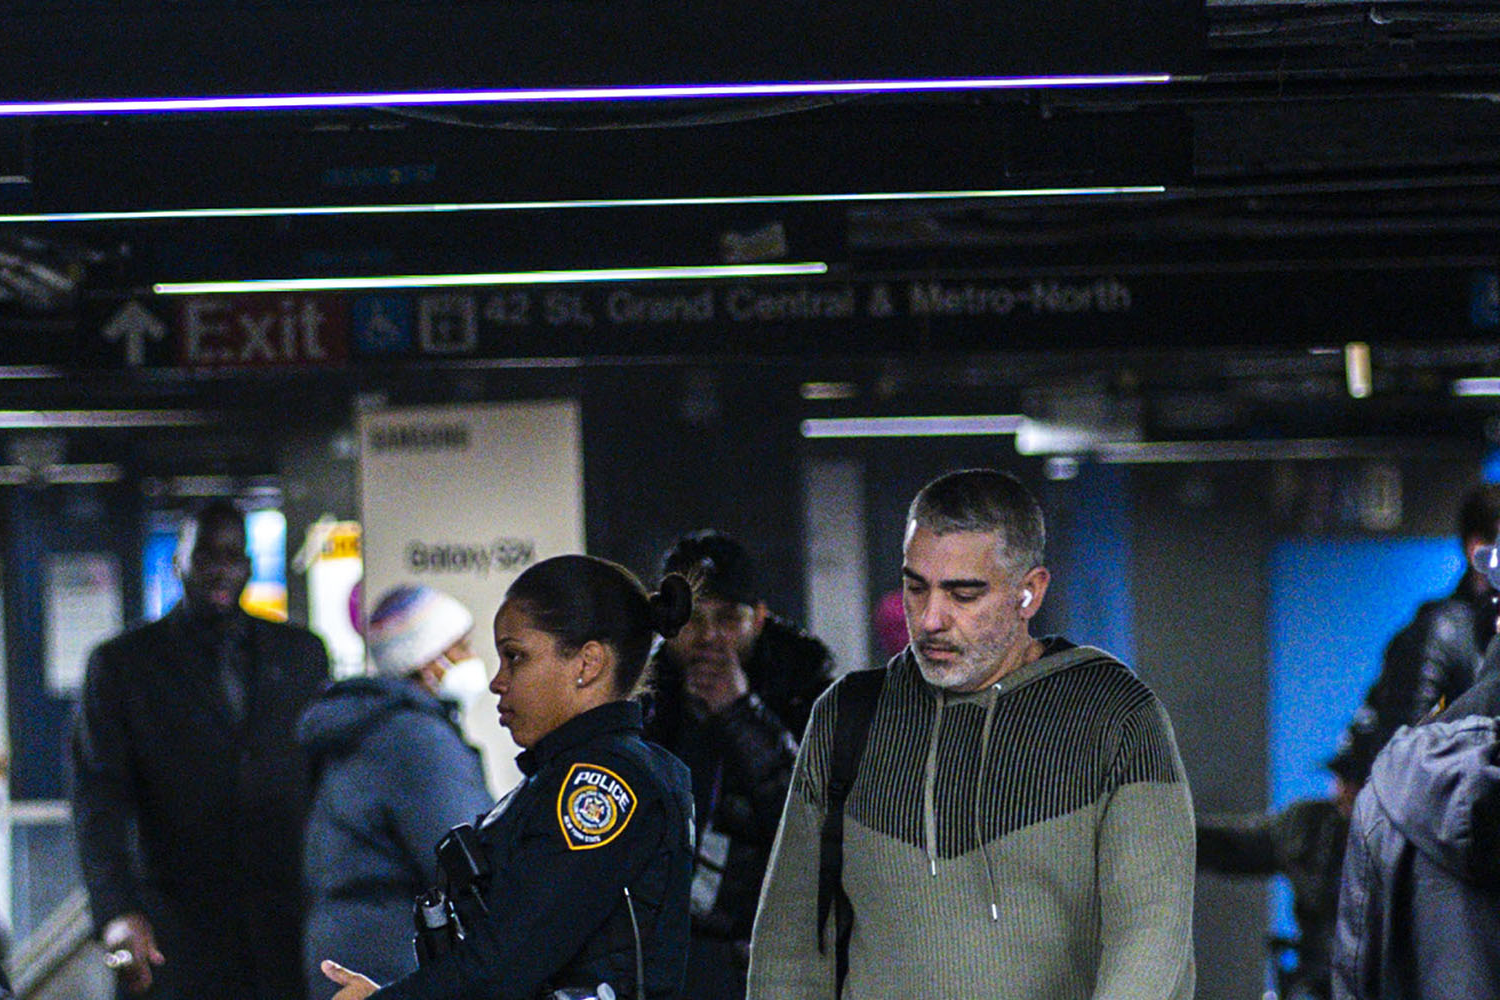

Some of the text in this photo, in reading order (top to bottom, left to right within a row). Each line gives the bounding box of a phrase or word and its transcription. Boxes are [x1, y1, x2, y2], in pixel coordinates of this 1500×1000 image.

[484, 297, 529, 326] 42
[607, 288, 715, 323] Grand
[727, 284, 854, 320] Central
[867, 284, 894, 317] &
[909, 280, 1133, 316] Metro-North
[183, 296, 328, 362] Exit
[408, 542, 490, 575] Galaxy
[573, 770, 630, 813] POLICE
